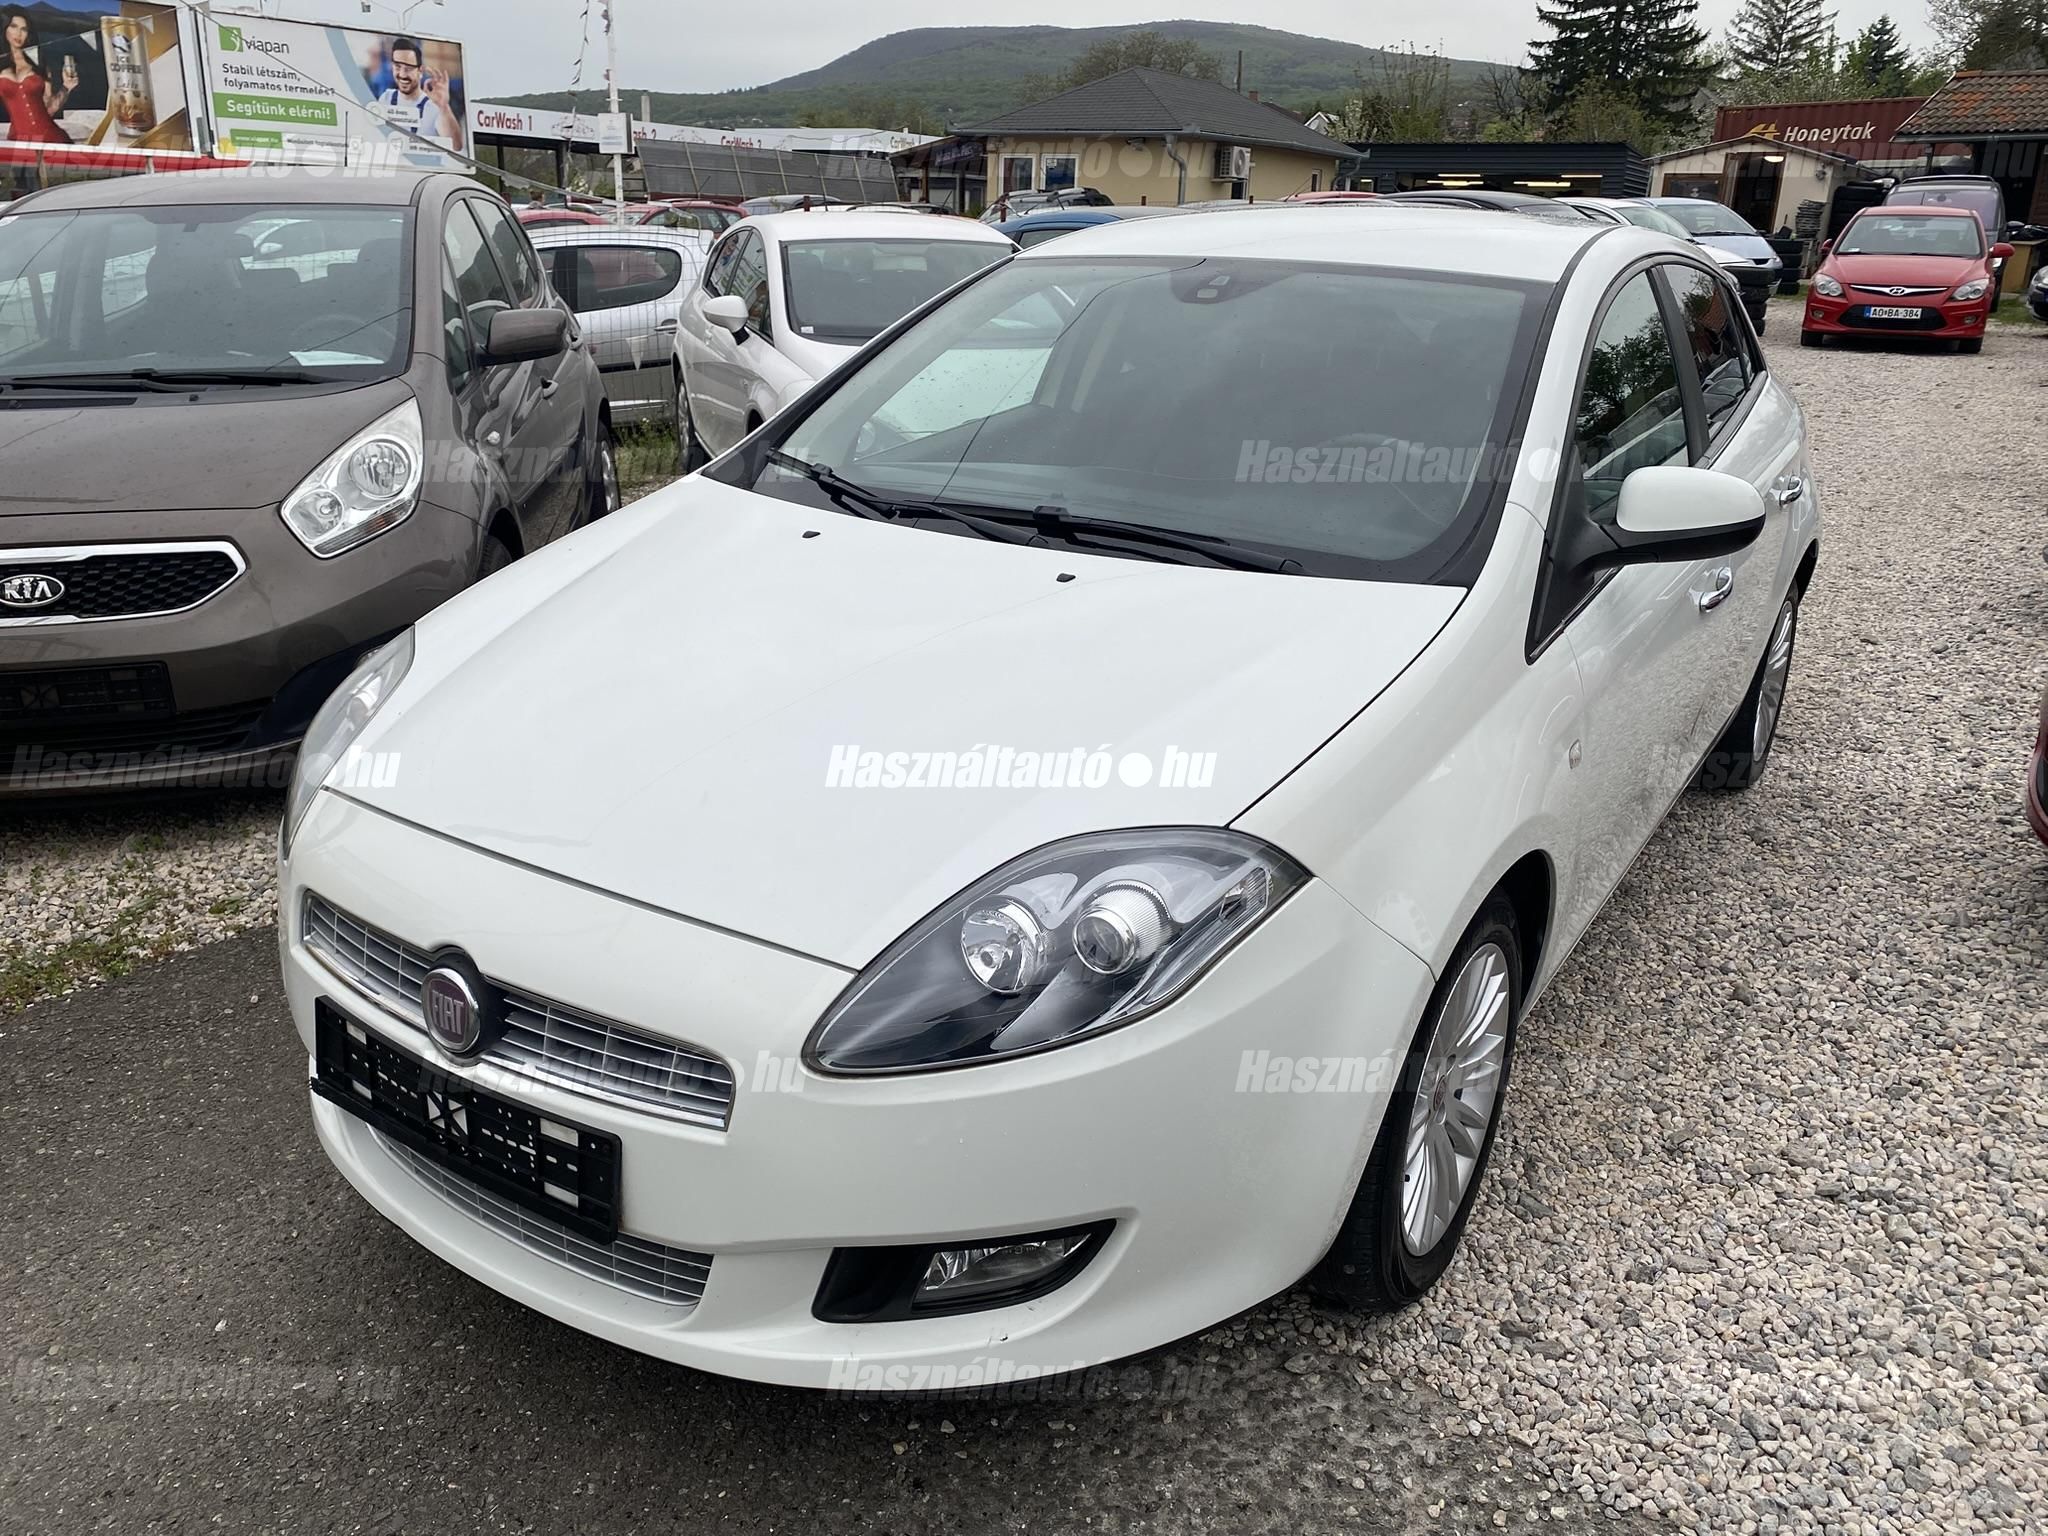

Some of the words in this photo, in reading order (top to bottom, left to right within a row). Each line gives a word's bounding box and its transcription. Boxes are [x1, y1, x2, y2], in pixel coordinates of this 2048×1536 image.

[244, 35, 290, 54] viapan
[222, 63, 254, 76] Stabil
[256, 65, 300, 81] létszám,
[223, 77, 282, 92] folyamatos
[227, 99, 286, 116] Segítünk
[289, 104, 331, 120] elérni!
[477, 110, 523, 131] CarWash
[528, 115, 533, 131] 1
[1783, 121, 1876, 144] Honeytak
[4, 577, 53, 600] KIA
[431, 989, 464, 1035] FIAT
